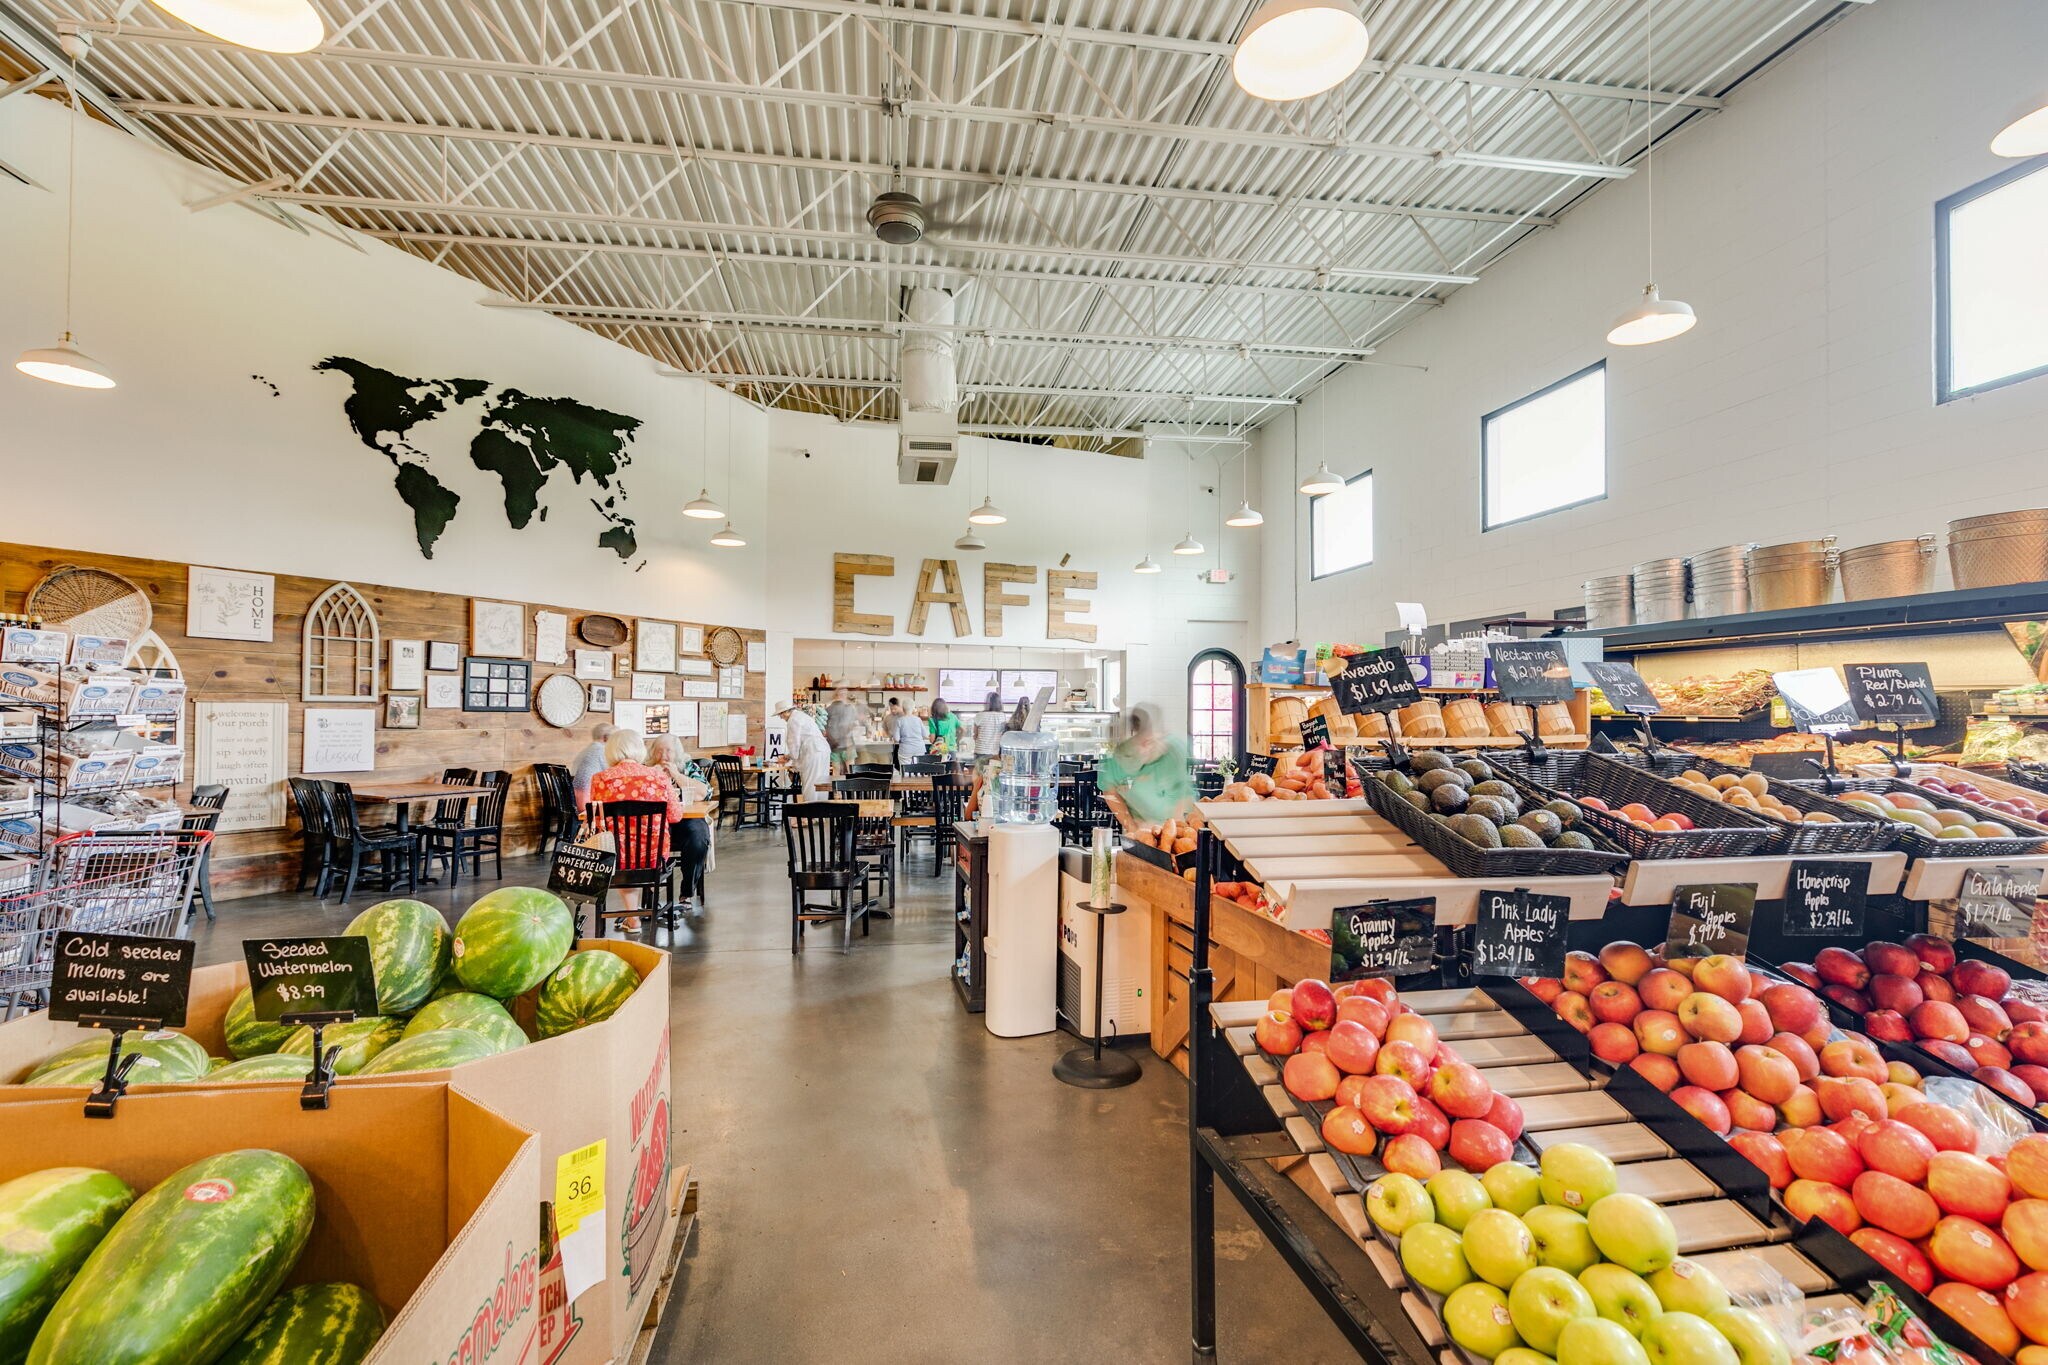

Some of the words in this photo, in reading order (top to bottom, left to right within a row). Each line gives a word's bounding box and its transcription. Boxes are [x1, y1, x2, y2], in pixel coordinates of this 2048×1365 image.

[833, 552, 1098, 643] CAFÉ
[252, 586, 264, 630] HOME
[1496, 648, 1558, 662] Nectarines
[1340, 656, 1395, 680] Avacado
[1856, 667, 1903, 679] Plums
[1864, 694, 1904, 708] $2.79
[218, 710, 257, 718] welcome
[239, 719, 268, 730] porch
[216, 749, 231, 759] sip
[238, 747, 267, 758] slowly
[216, 761, 241, 770] laugh
[243, 761, 268, 769] often
[216, 773, 267, 786] unwind
[235, 813, 266, 823] awhile
[562, 845, 602, 860] SEEDLESS
[558, 855, 612, 874] WATERMELON
[558, 866, 593, 885] $8.99
[1797, 869, 1851, 894] Honeycrisp
[1970, 872, 2002, 896] Gala
[2005, 879, 2039, 898] Apples
[1690, 891, 1717, 918] Fuji
[1804, 891, 1830, 911] Apples
[1491, 896, 1520, 920] Pink
[1525, 903, 1558, 929] Lady
[1706, 910, 1736, 929] Apples
[1350, 914, 1395, 936] Granny
[1504, 922, 1544, 943] Apples
[64, 937, 109, 958] Cold
[121, 944, 181, 962] seeded
[261, 942, 328, 959] Seeded
[1360, 933, 1395, 951] Apples
[141, 971, 170, 983] are
[258, 960, 352, 978] Watermelon
[65, 987, 148, 1005] available!
[276, 983, 325, 1002] $8.99
[568, 1175, 591, 1201] 36
[539, 1279, 561, 1316] TCH
